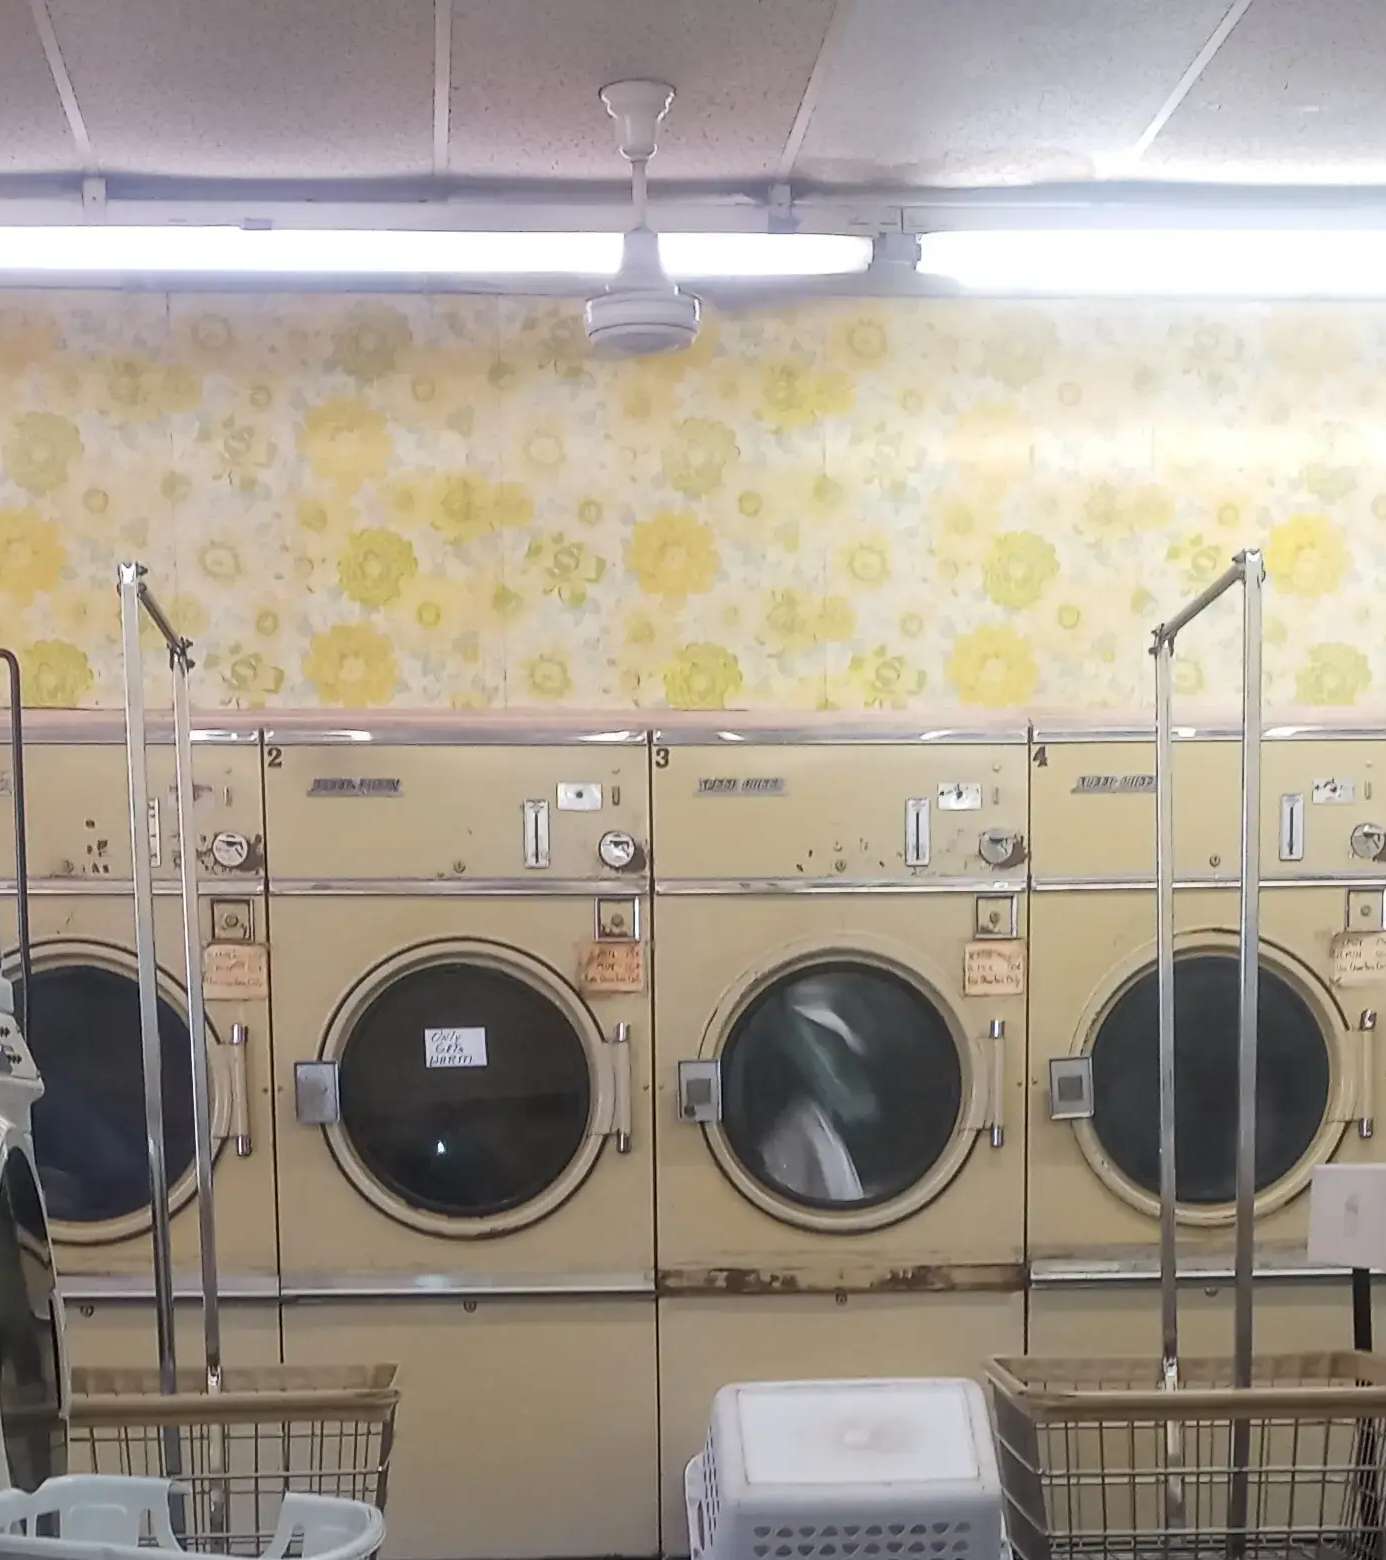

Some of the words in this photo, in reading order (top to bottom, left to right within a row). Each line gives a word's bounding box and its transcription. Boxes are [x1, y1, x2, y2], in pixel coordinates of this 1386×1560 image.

[267, 747, 282, 768] 2
[655, 747, 670, 768] 3
[1033, 745, 1048, 768] 4
